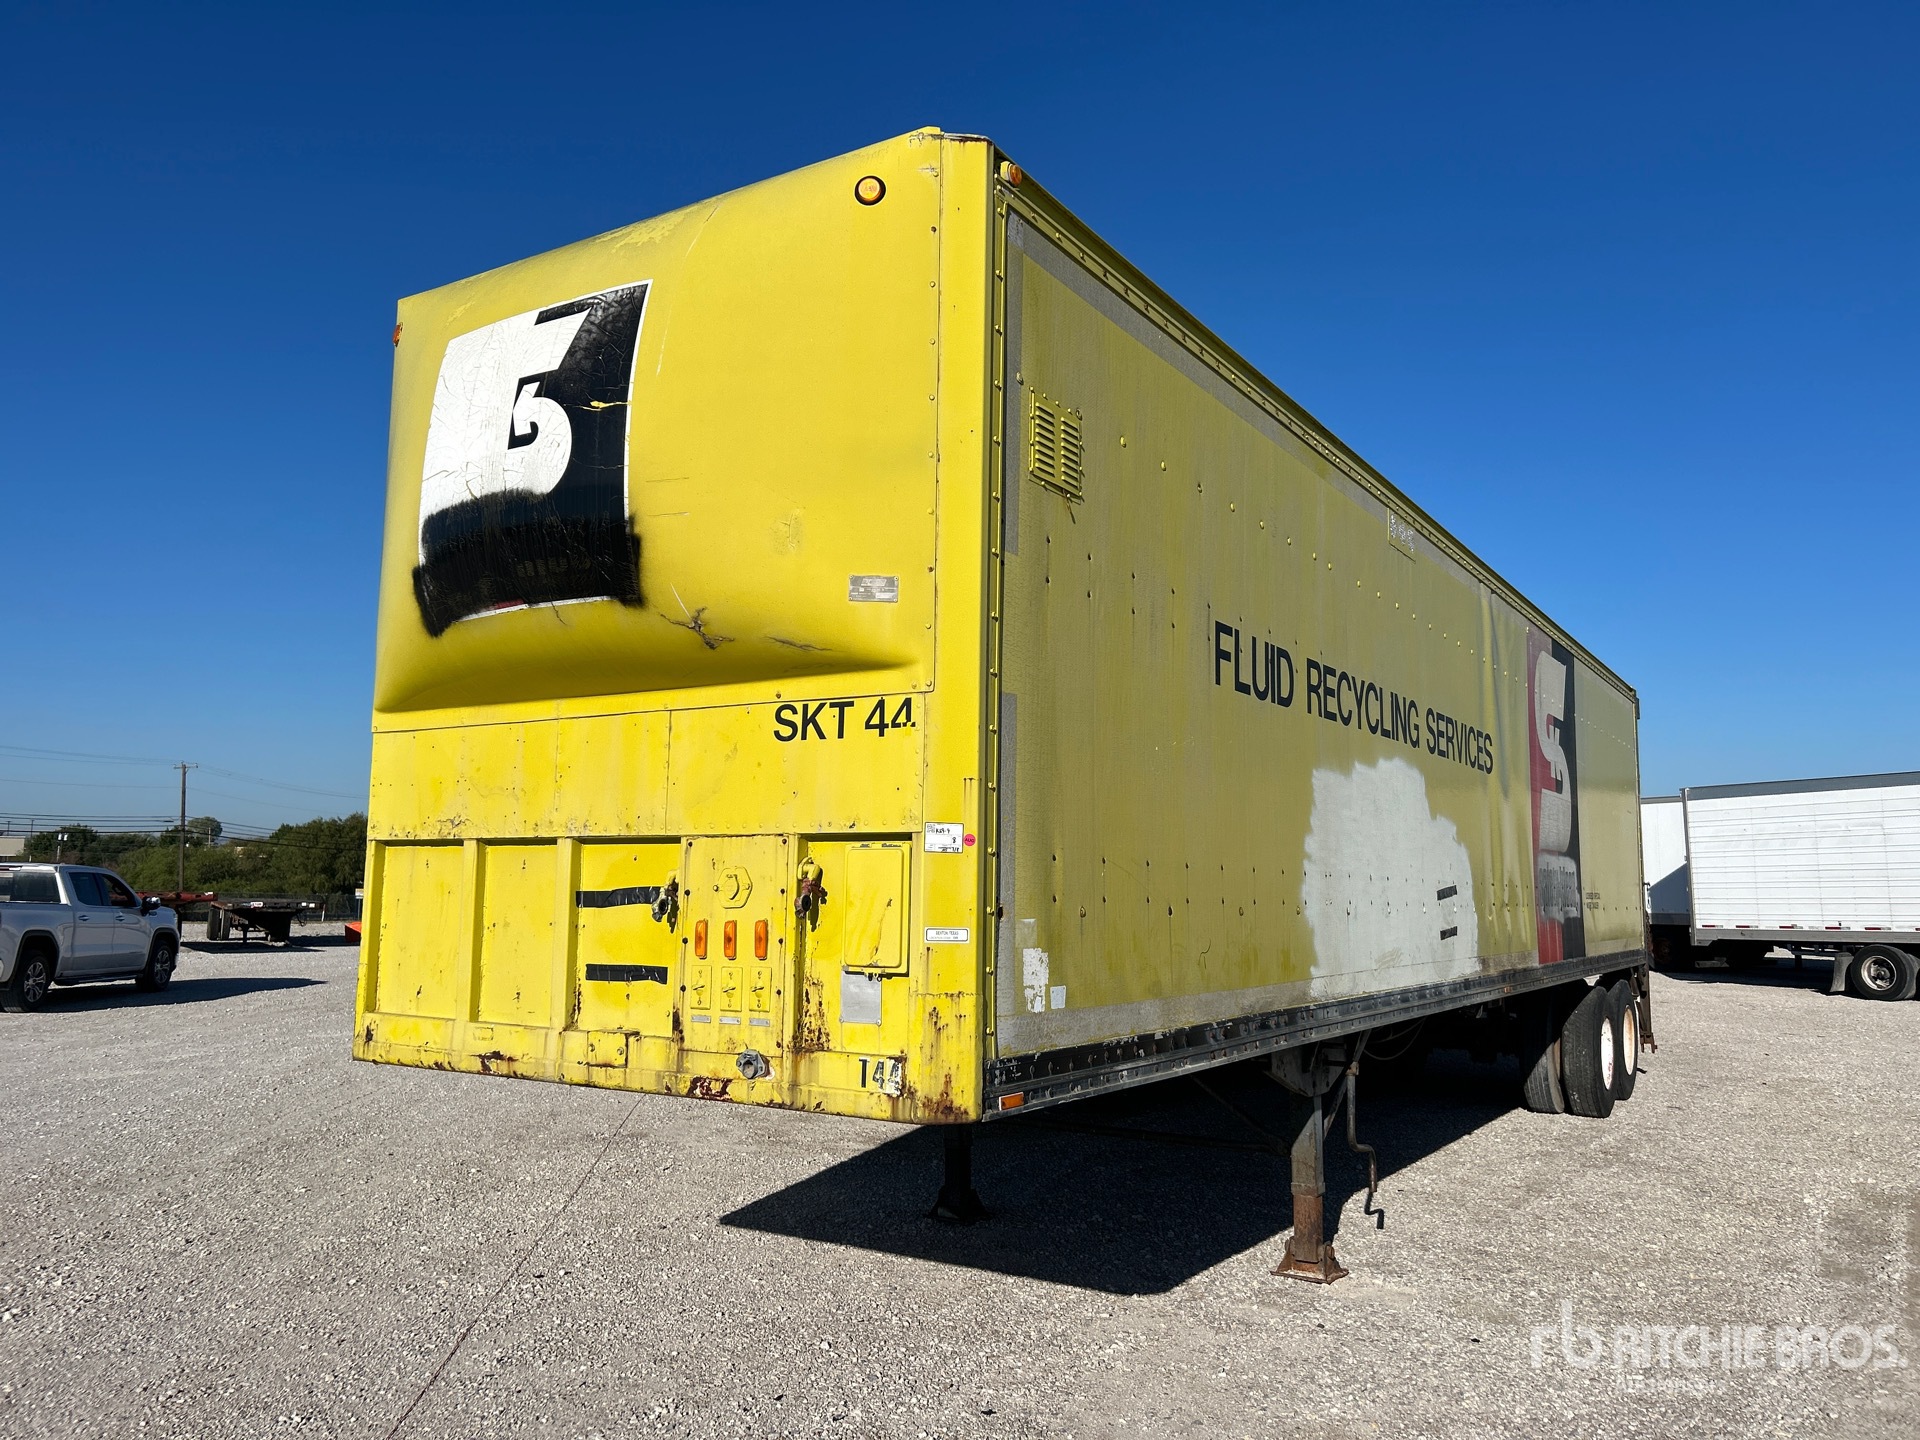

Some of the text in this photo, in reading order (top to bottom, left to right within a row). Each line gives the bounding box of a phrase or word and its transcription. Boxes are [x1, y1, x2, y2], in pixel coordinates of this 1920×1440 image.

[773, 697, 916, 742] SKT 44
[1214, 620, 1494, 775] FLUID RECYCLING SERVICES
